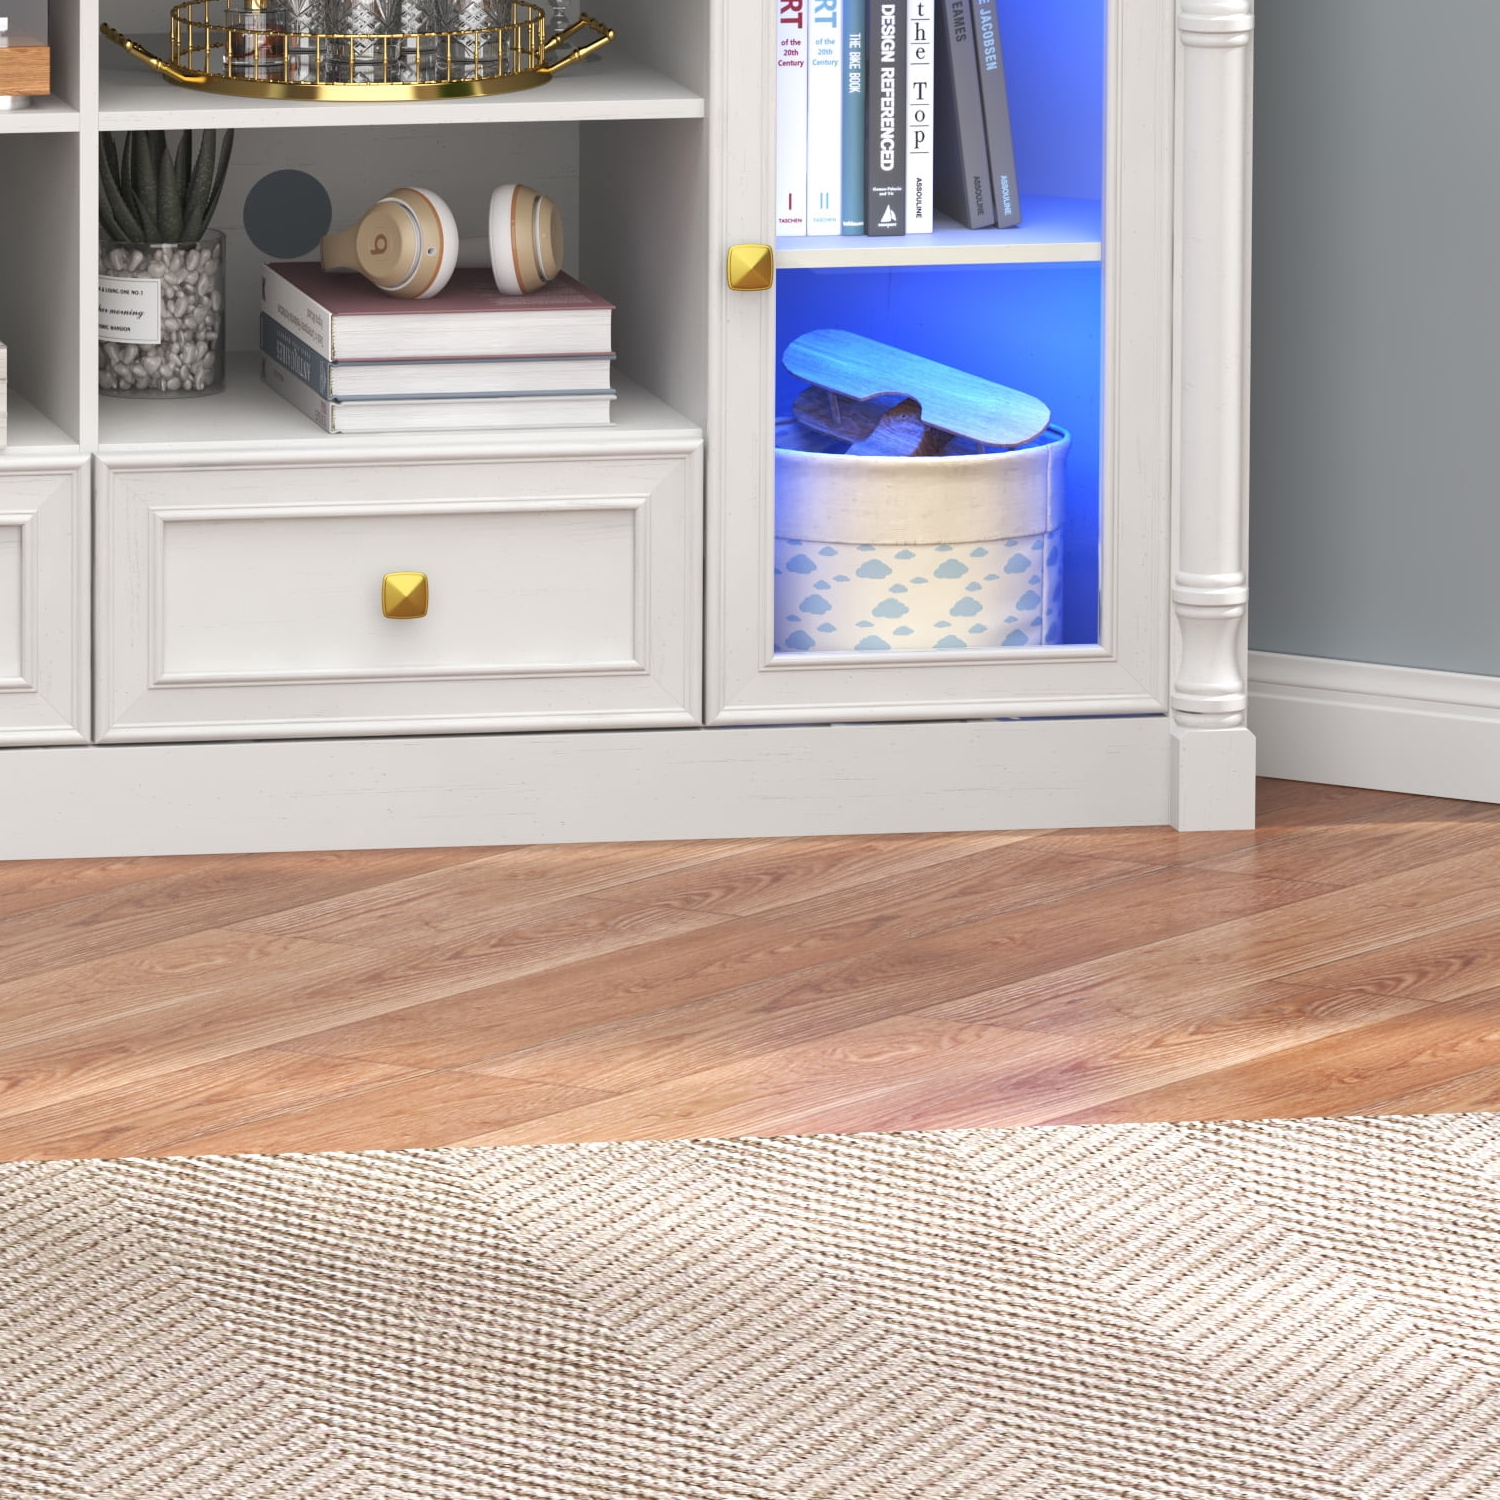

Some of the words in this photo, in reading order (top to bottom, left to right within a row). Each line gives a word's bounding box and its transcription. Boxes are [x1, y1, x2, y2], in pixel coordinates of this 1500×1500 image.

[781, 38, 788, 46] of
[790, 38, 801, 46] the
[849, 33, 861, 48] THE
[881, 4, 896, 62] DESIGN
[913, 1, 927, 61] the
[951, 1, 967, 43] EAMES
[980, 8, 998, 71] JACOBSEN
[778, 59, 804, 67] Century
[812, 58, 838, 67] Century
[849, 51, 861, 69] BIKE
[849, 72, 861, 93] BOOK
[880, 67, 896, 172] REFERENCED
[912, 80, 928, 150] Top
[999, 175, 1012, 216] ASSOULINE
